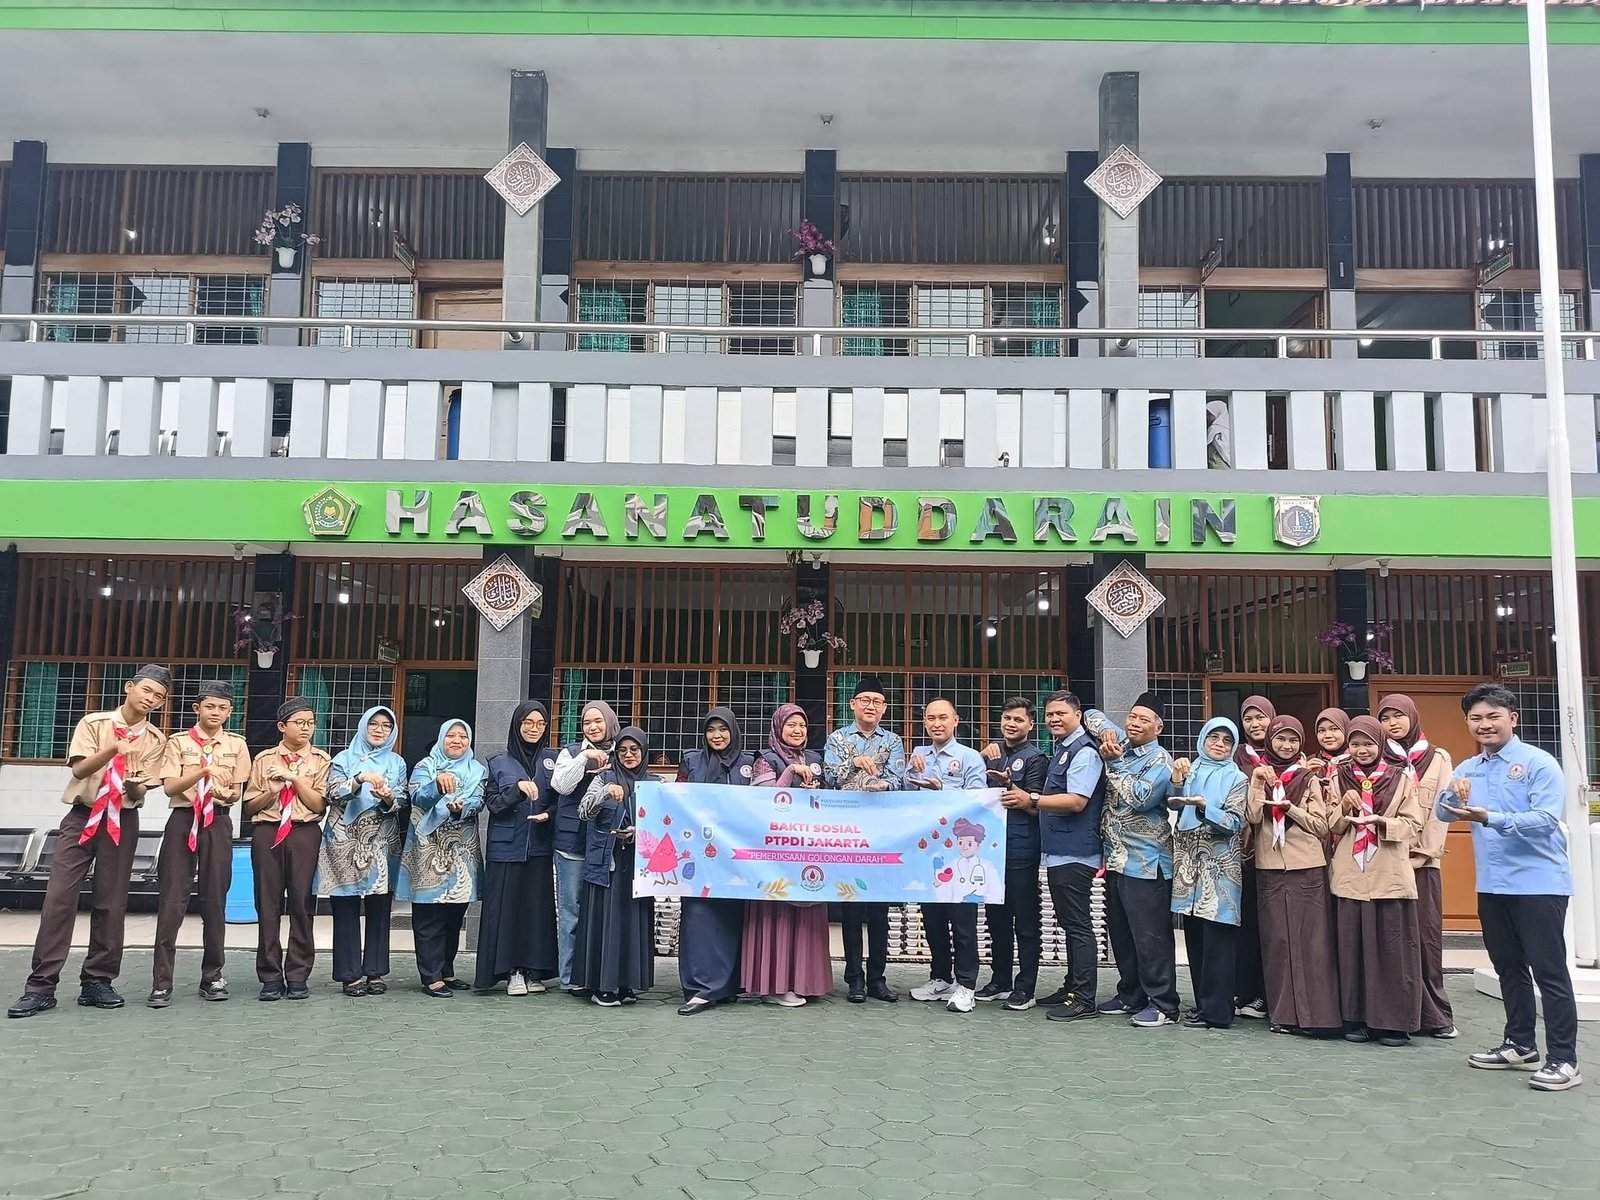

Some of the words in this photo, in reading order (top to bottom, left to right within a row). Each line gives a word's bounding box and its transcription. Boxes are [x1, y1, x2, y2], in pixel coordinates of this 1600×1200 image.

[385, 489, 1237, 545] HASANATUDDARAIN
[769, 821, 809, 832] BAKTI
[813, 824, 861, 834] SOSIAL
[765, 836, 805, 847] PTPDI
[807, 837, 870, 848] JAKARTA
[807, 854, 853, 863] GOLONGAN
